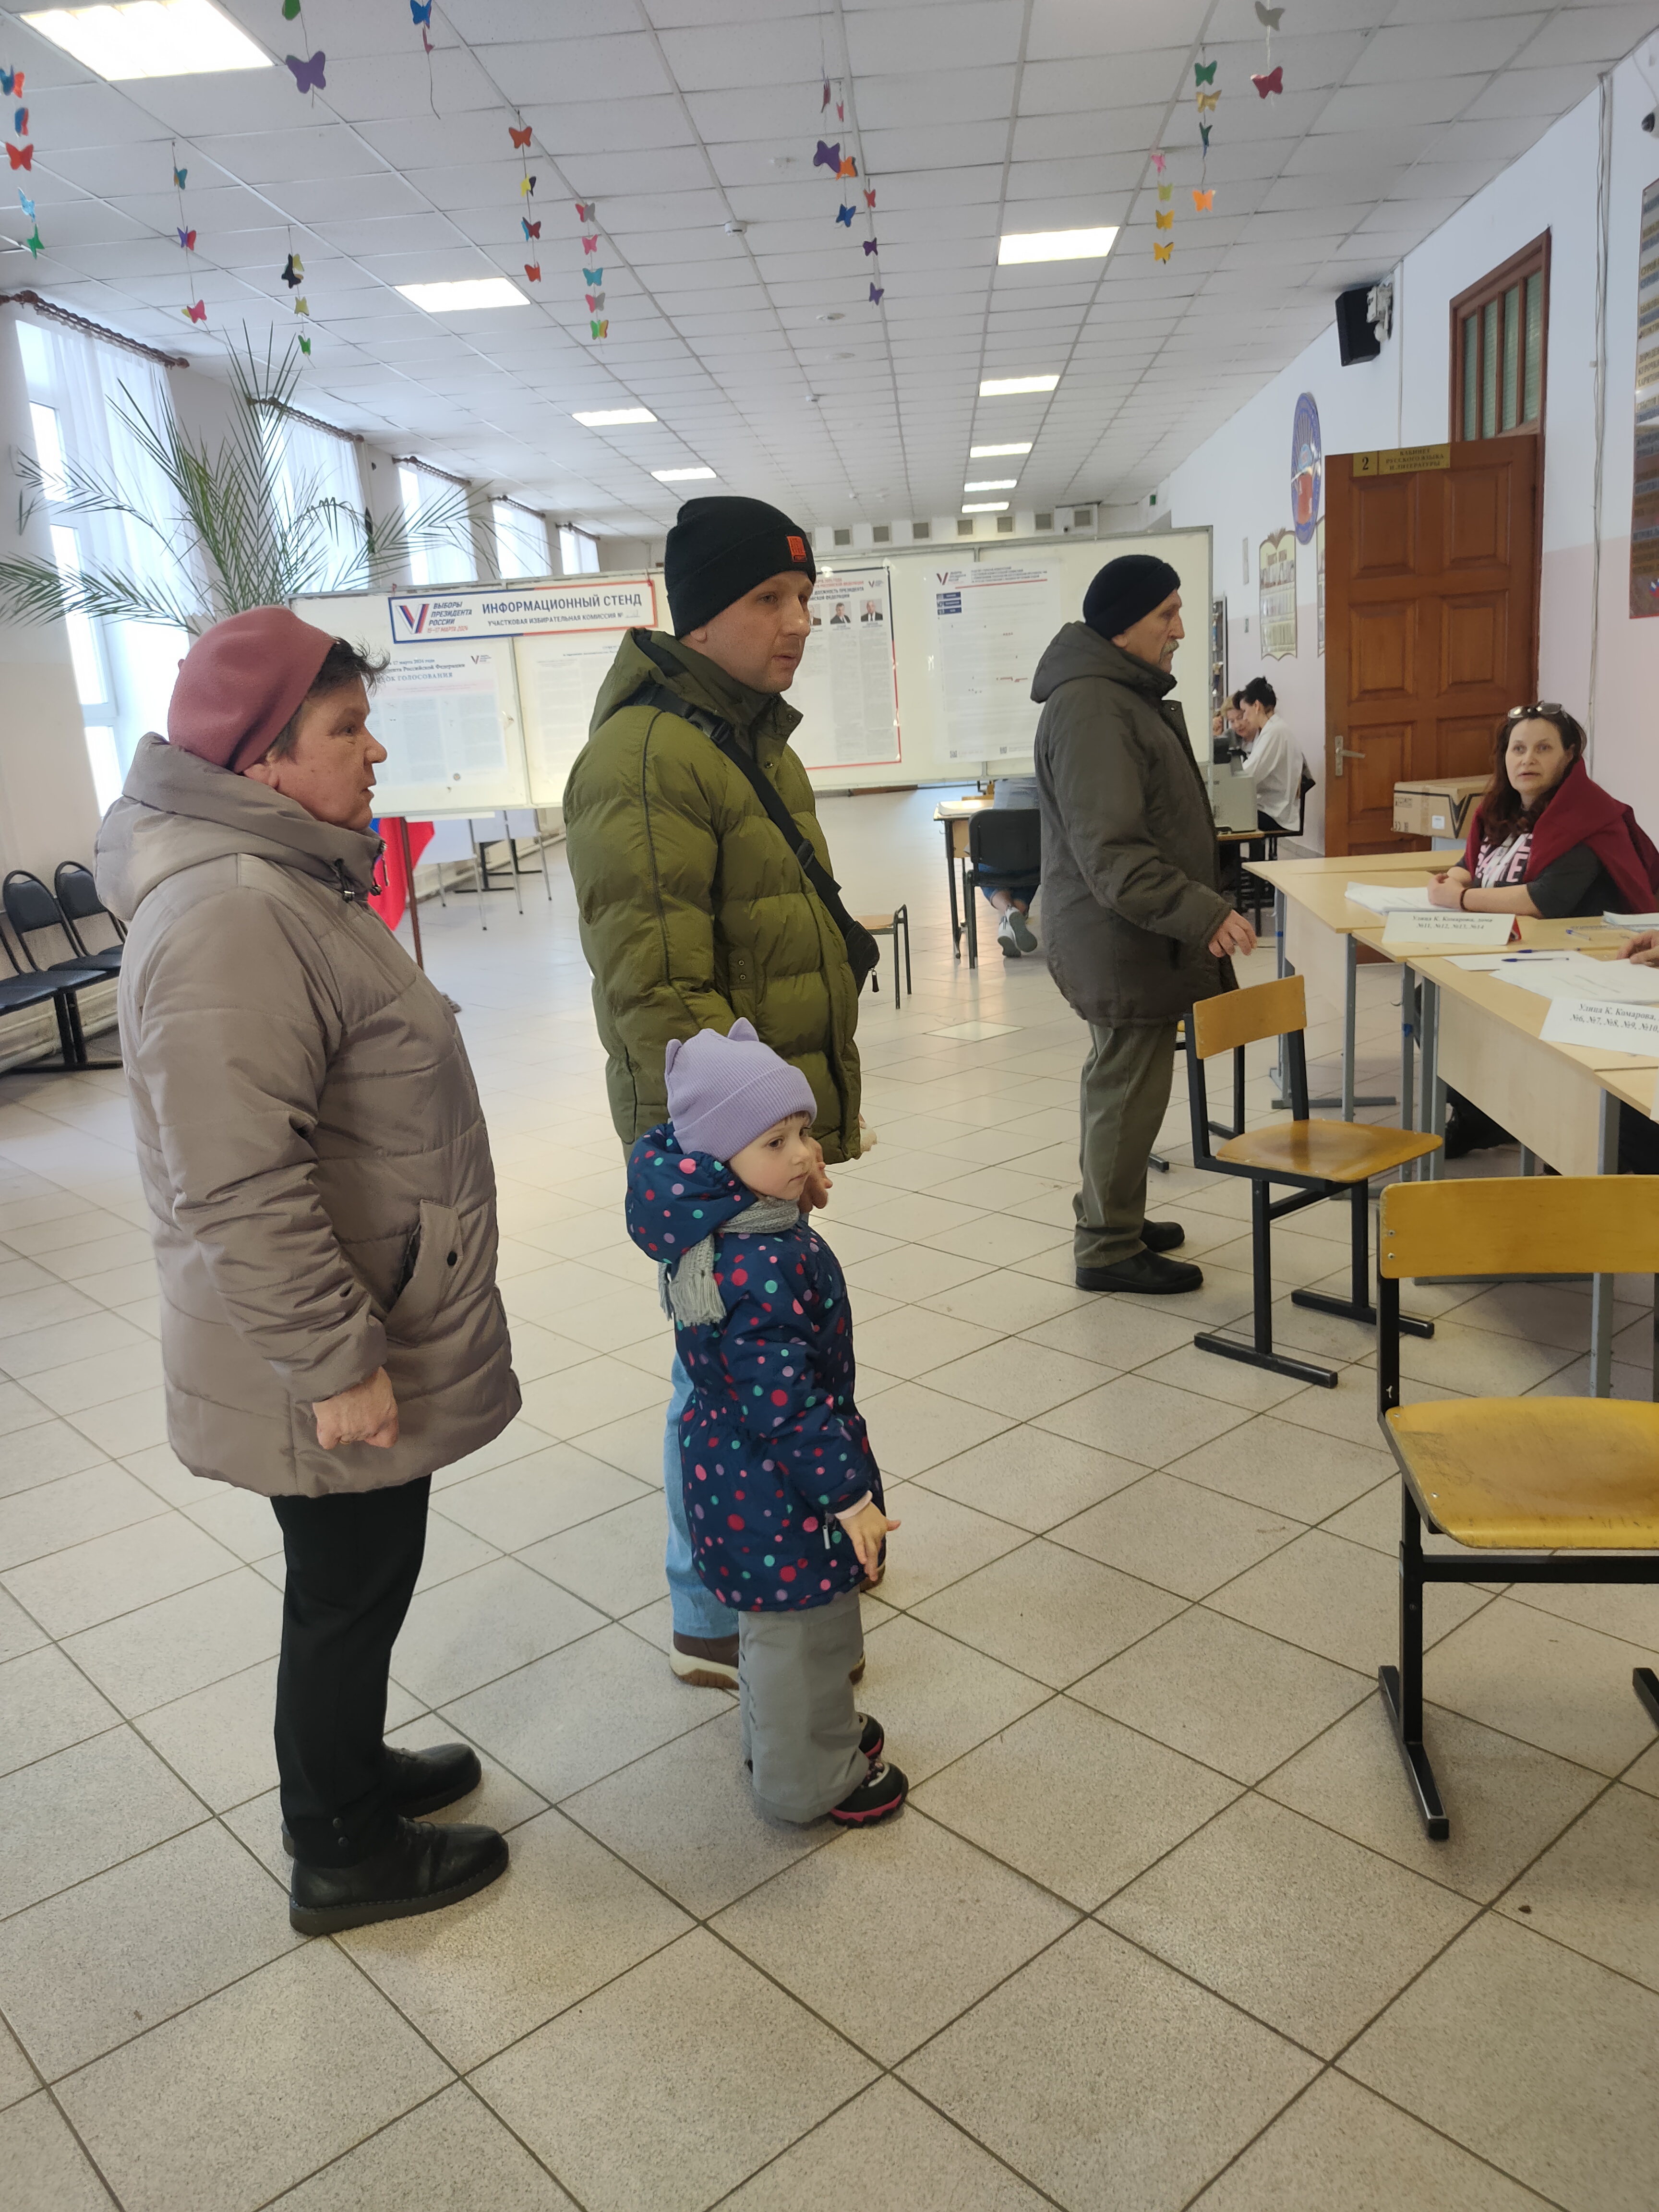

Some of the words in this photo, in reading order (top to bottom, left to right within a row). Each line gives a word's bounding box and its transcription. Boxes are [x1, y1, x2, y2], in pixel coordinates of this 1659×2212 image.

[1362, 457, 1369, 470] 2
[433, 601, 463, 610] ВЫБОРЫ
[482, 594, 600, 614] ИНФОРМАЦИОННЫЙ
[603, 594, 642, 607] СТЕНД
[431, 609, 473, 618] ПРЕЗИДЕНТА
[488, 618, 528, 626] УЧАСТКОВАЯ
[529, 615, 581, 624] ИЗБИРАТЕЛЬНАЯ
[582, 613, 616, 621] КОМИССИЯ
[398, 673, 453, 681] ГОЛОСОВАНИЯ
[1578, 1003, 1603, 1013] Улица
[1570, 1014, 1585, 1023] №6,
[1587, 1016, 1602, 1025] №7,
[1603, 1019, 1619, 1028] №8,
[1621, 1021, 1636, 1030] №9,
[1638, 1022, 1659, 1033] №10,
